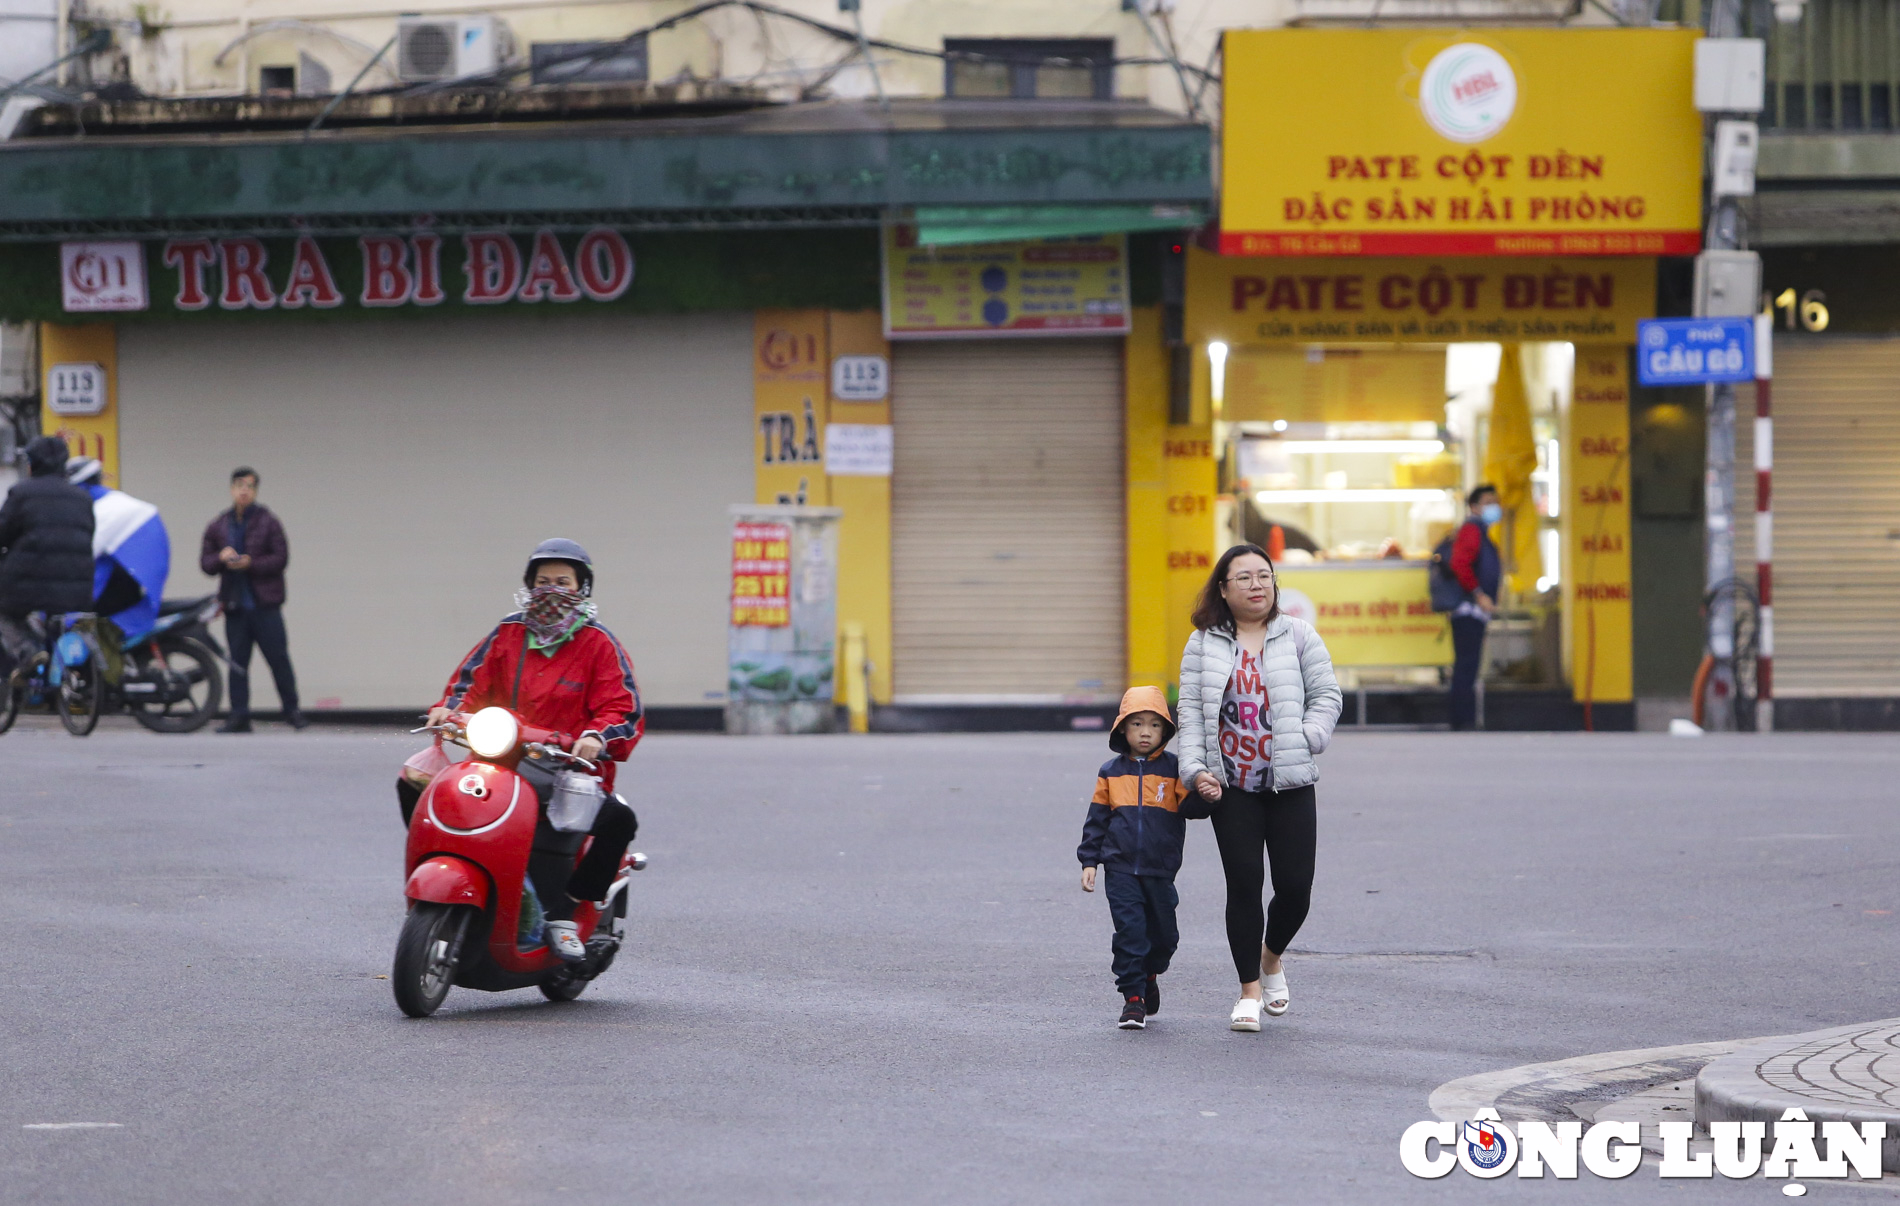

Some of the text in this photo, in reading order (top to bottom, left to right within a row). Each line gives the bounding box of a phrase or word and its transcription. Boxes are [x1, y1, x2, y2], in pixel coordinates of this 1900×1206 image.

[1327, 149, 1604, 186] PATE CỘT ĐÈN
[1366, 187, 1436, 221] SẢN
[1449, 187, 1513, 221] HẢI
[1529, 191, 1646, 221] PHÒNG
[461, 227, 633, 303] ĐAO
[1232, 264, 1614, 316] PATE CỘT ĐÈN
[1651, 338, 1744, 374] CẦU GỖ
[733, 575, 761, 597] 25
